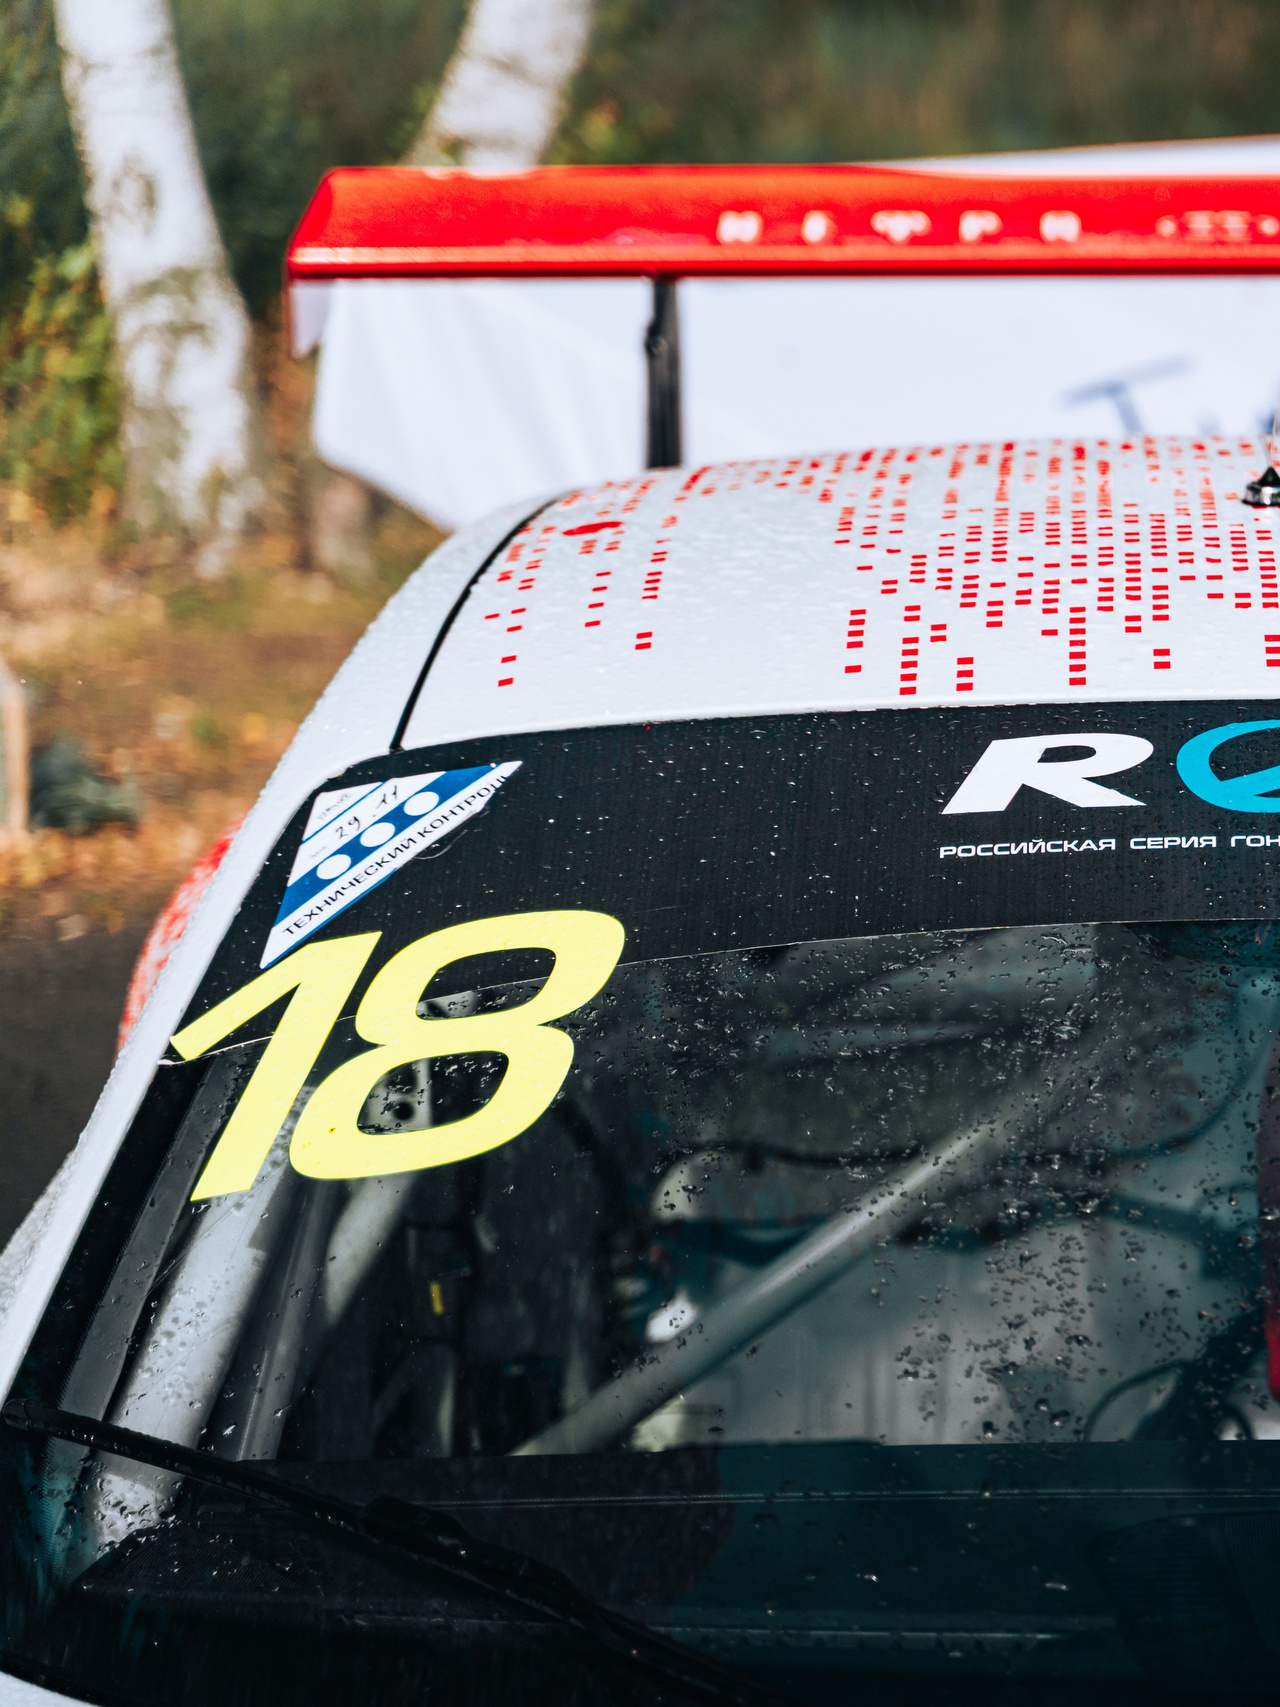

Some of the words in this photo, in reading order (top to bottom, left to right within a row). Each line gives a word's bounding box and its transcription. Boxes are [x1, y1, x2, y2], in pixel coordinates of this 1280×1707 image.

[282, 836, 417, 936] ТЕХНИЧЕСКИЙ
[939, 838, 1117, 859] РОССИЙСКАЯ
[1129, 837, 1217, 850] СЕРИЯ
[171, 910, 626, 1202] 18
